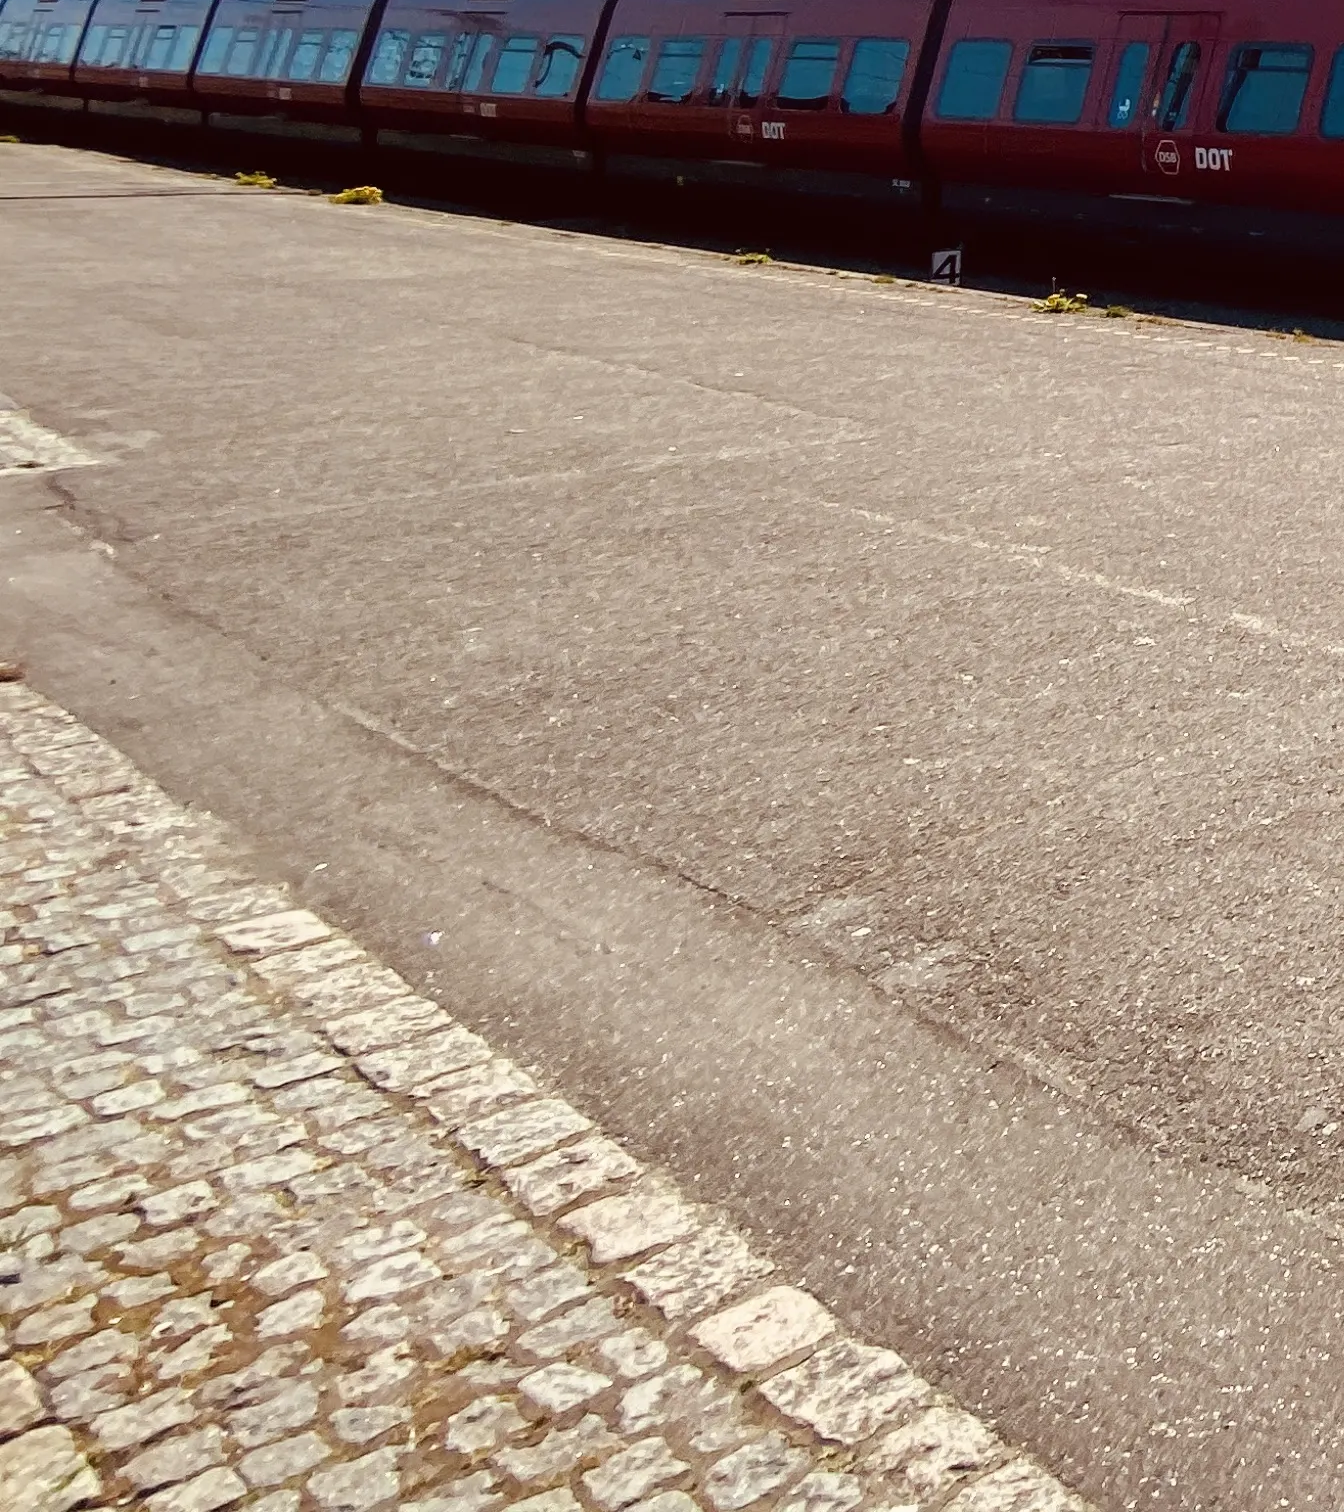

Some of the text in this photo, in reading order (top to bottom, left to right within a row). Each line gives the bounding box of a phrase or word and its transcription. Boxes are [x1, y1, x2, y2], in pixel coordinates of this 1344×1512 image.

[761, 121, 786, 140] DOT
[1195, 147, 1233, 171] DOT
[930, 254, 961, 285] 4
